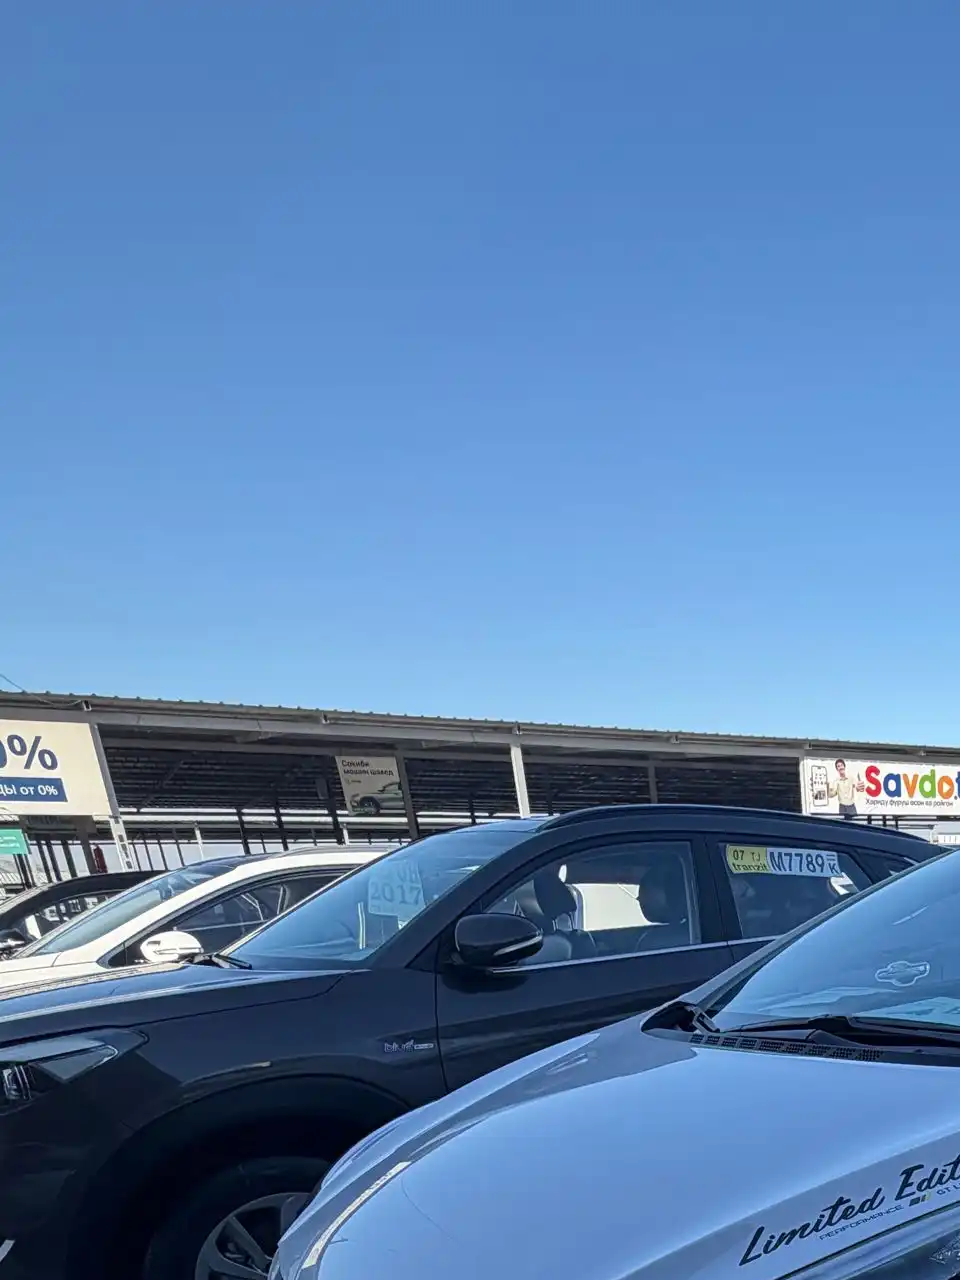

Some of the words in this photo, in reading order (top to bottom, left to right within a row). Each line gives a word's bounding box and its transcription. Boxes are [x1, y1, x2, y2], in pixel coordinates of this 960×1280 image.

[20, 786, 35, 795] от
[38, 785, 58, 796] 0%
[731, 861, 769, 872] tranzit
[732, 849, 745, 861] 07
[769, 851, 825, 873] M7789
[827, 862, 839, 874] K
[371, 882, 421, 906] 2017
[936, 1186, 951, 1196] GT
[738, 1187, 886, 1266] Limited
